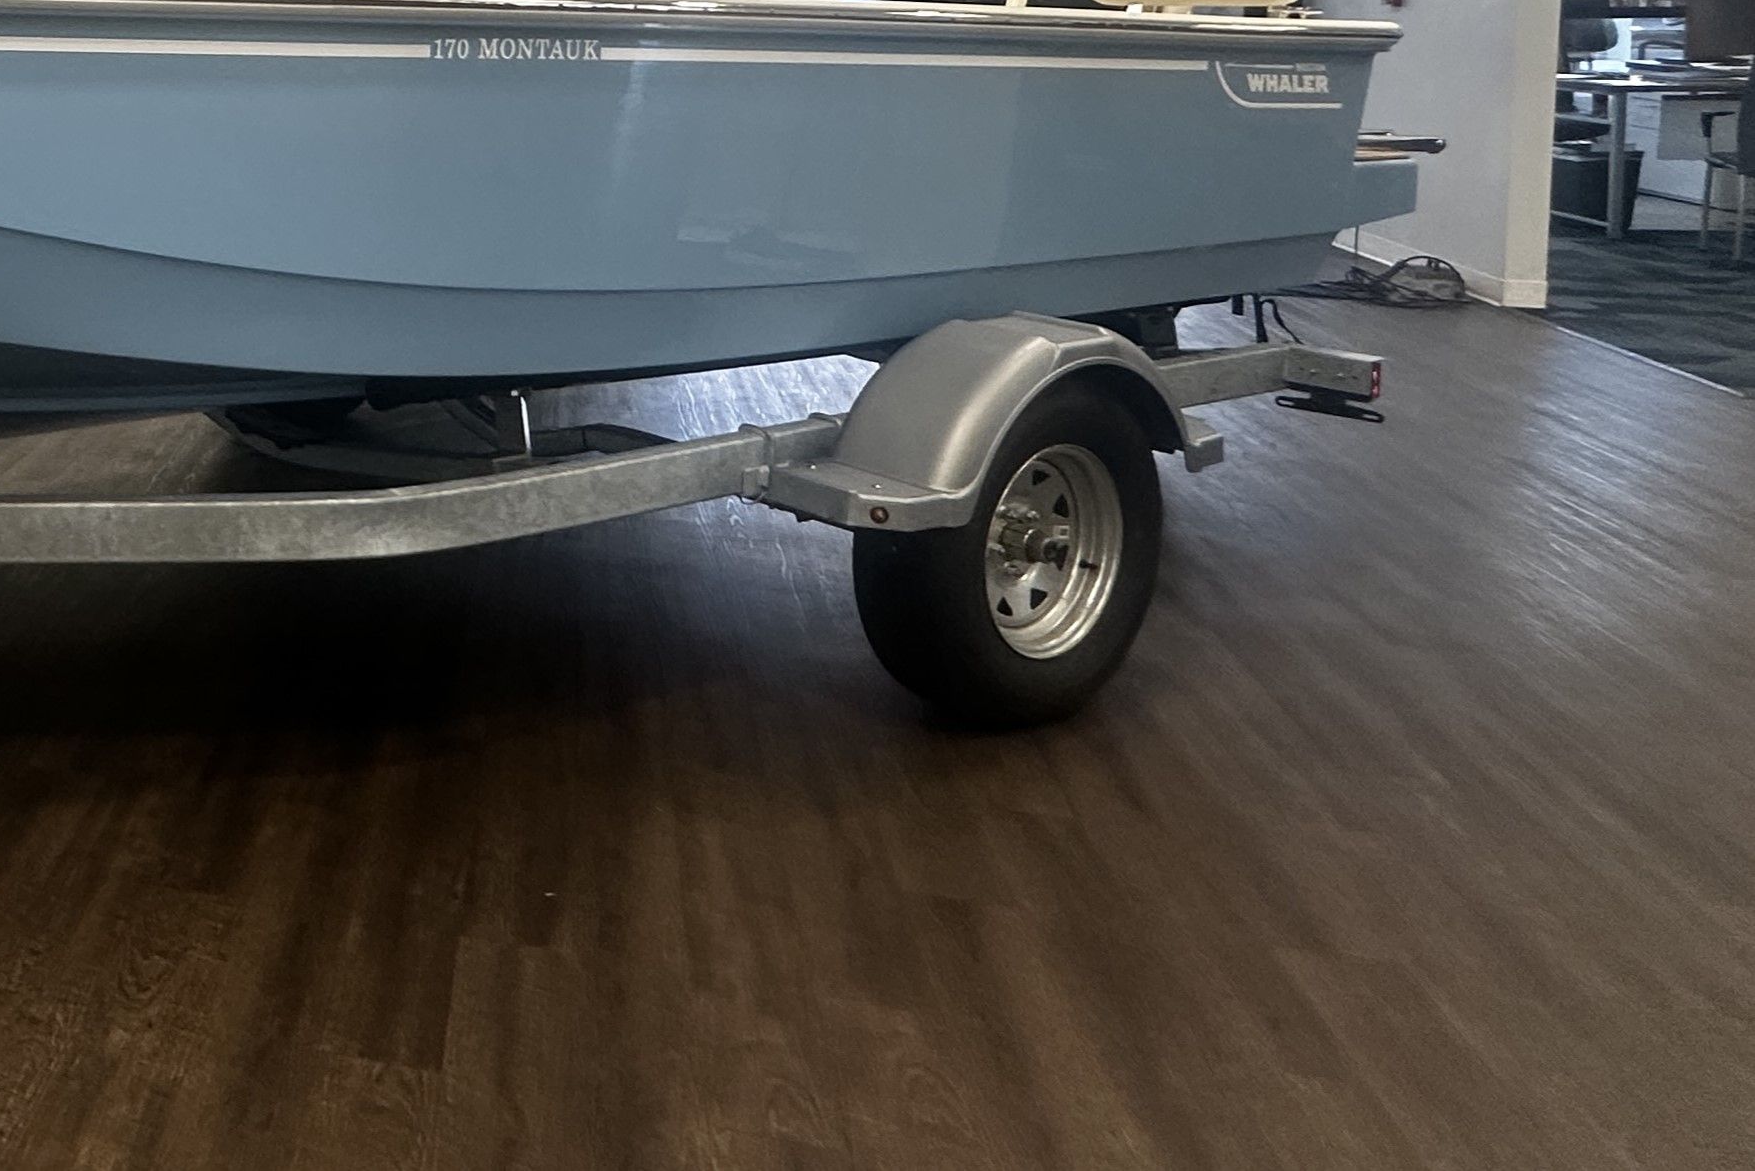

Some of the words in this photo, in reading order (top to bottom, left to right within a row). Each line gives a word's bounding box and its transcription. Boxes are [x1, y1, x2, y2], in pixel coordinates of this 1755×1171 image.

[434, 39, 469, 59] 170
[478, 38, 599, 59] MONTAUK
[1246, 73, 1330, 93] WHALER
